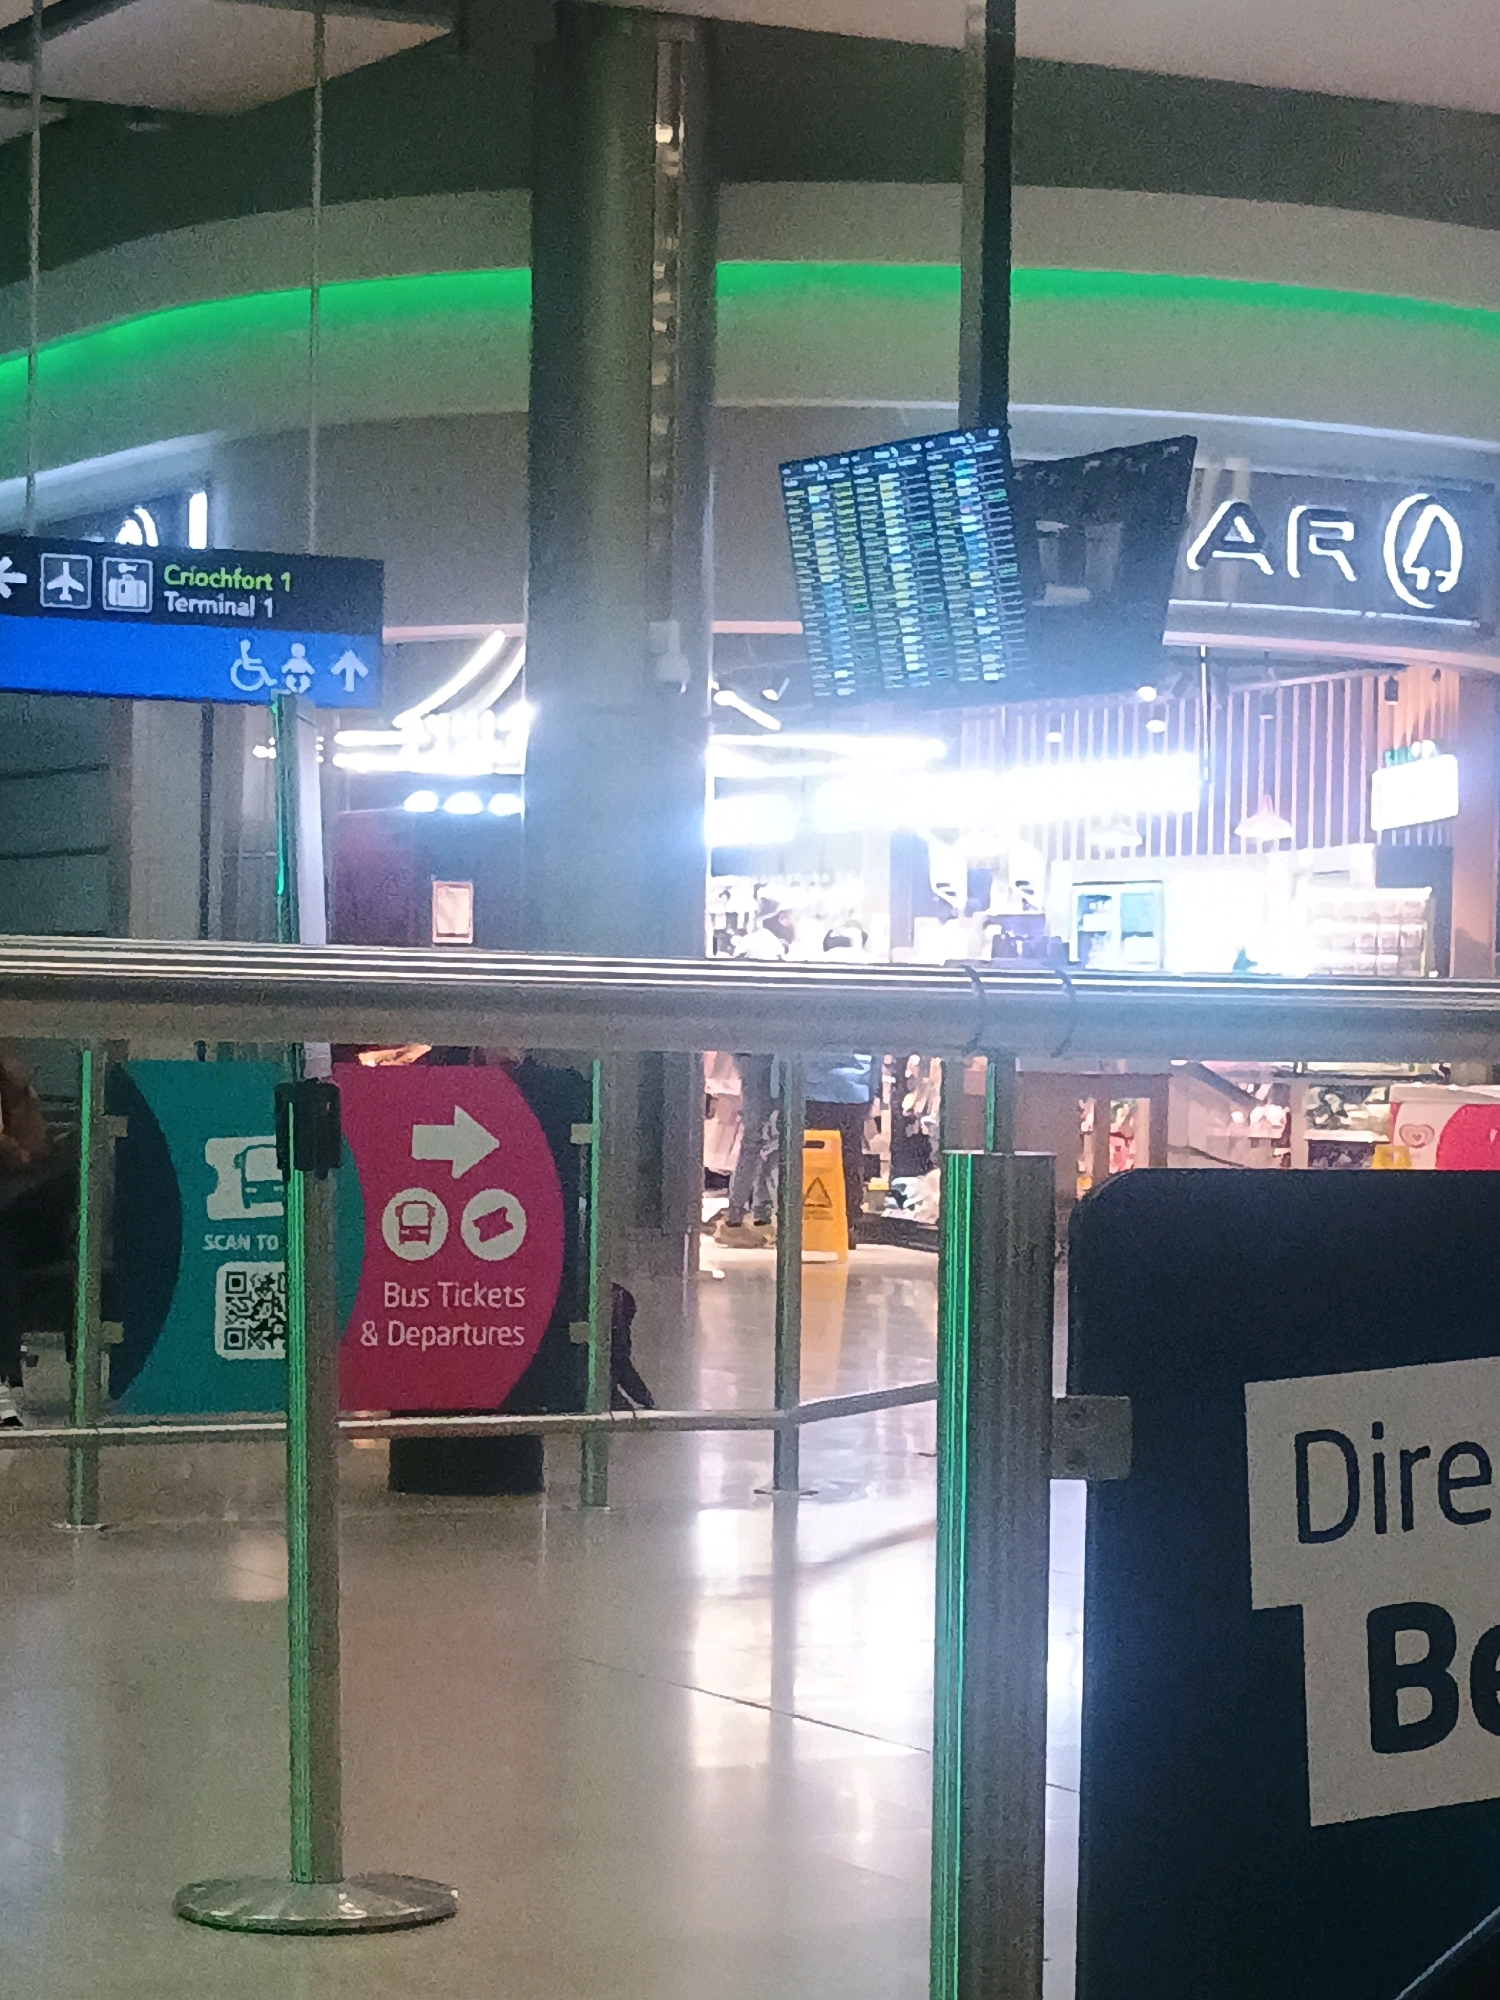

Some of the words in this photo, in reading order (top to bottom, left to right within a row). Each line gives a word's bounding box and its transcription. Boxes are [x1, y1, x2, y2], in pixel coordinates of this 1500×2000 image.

[281, 571, 291, 592] 1
[163, 590, 255, 618] Terminal
[264, 597, 273, 618] 1
[202, 1233, 251, 1251] SCAN
[256, 1234, 279, 1251] TO
[384, 1281, 430, 1308] Bus
[437, 1278, 527, 1309] Tickets
[360, 1320, 378, 1347] &
[387, 1319, 525, 1352] Departures
[1294, 1421, 1493, 1544] Dire
